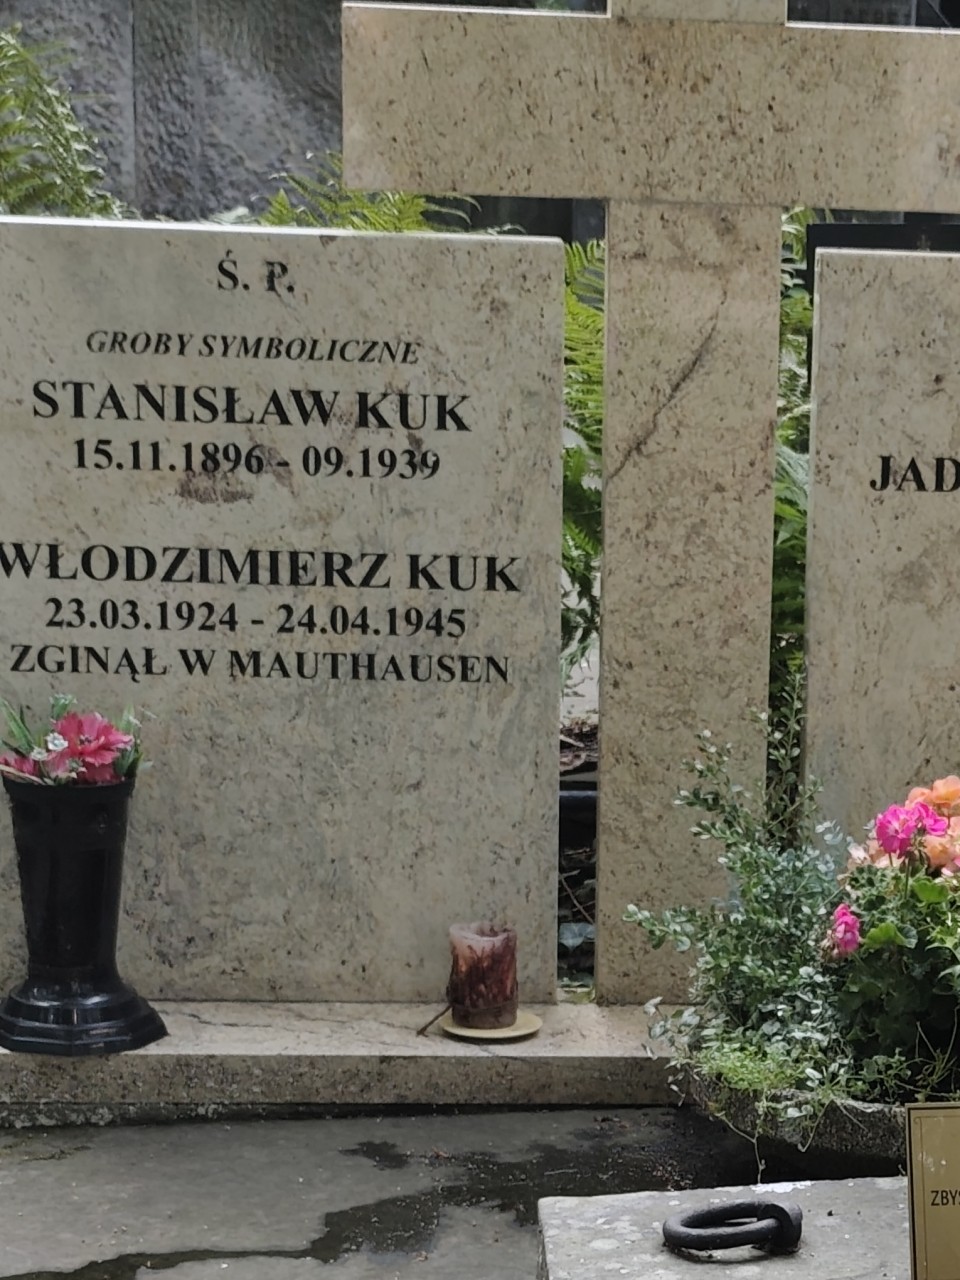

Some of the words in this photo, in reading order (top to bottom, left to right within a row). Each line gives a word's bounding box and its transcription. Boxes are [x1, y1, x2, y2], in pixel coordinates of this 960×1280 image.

[217, 250, 251, 292] Ś.
[265, 260, 295, 293] P.
[86, 330, 194, 357] GROBY
[198, 333, 420, 365] SYMBOLICZNE
[31, 380, 340, 427] STANISŁAW
[355, 391, 472, 433] KUK
[74, 437, 264, 475] 15.11.1896
[302, 444, 441, 480] 09.1939
[0, 542, 392, 590] WŁODZIMIERZ
[406, 552, 522, 593] KUK
[45, 597, 239, 633] 23.03.1924
[276, 603, 467, 639] 24.04.1945
[10, 643, 168, 684] ZGINĄŁ
[178, 648, 217, 678] W
[228, 650, 510, 684] MAUTHAUSEN
